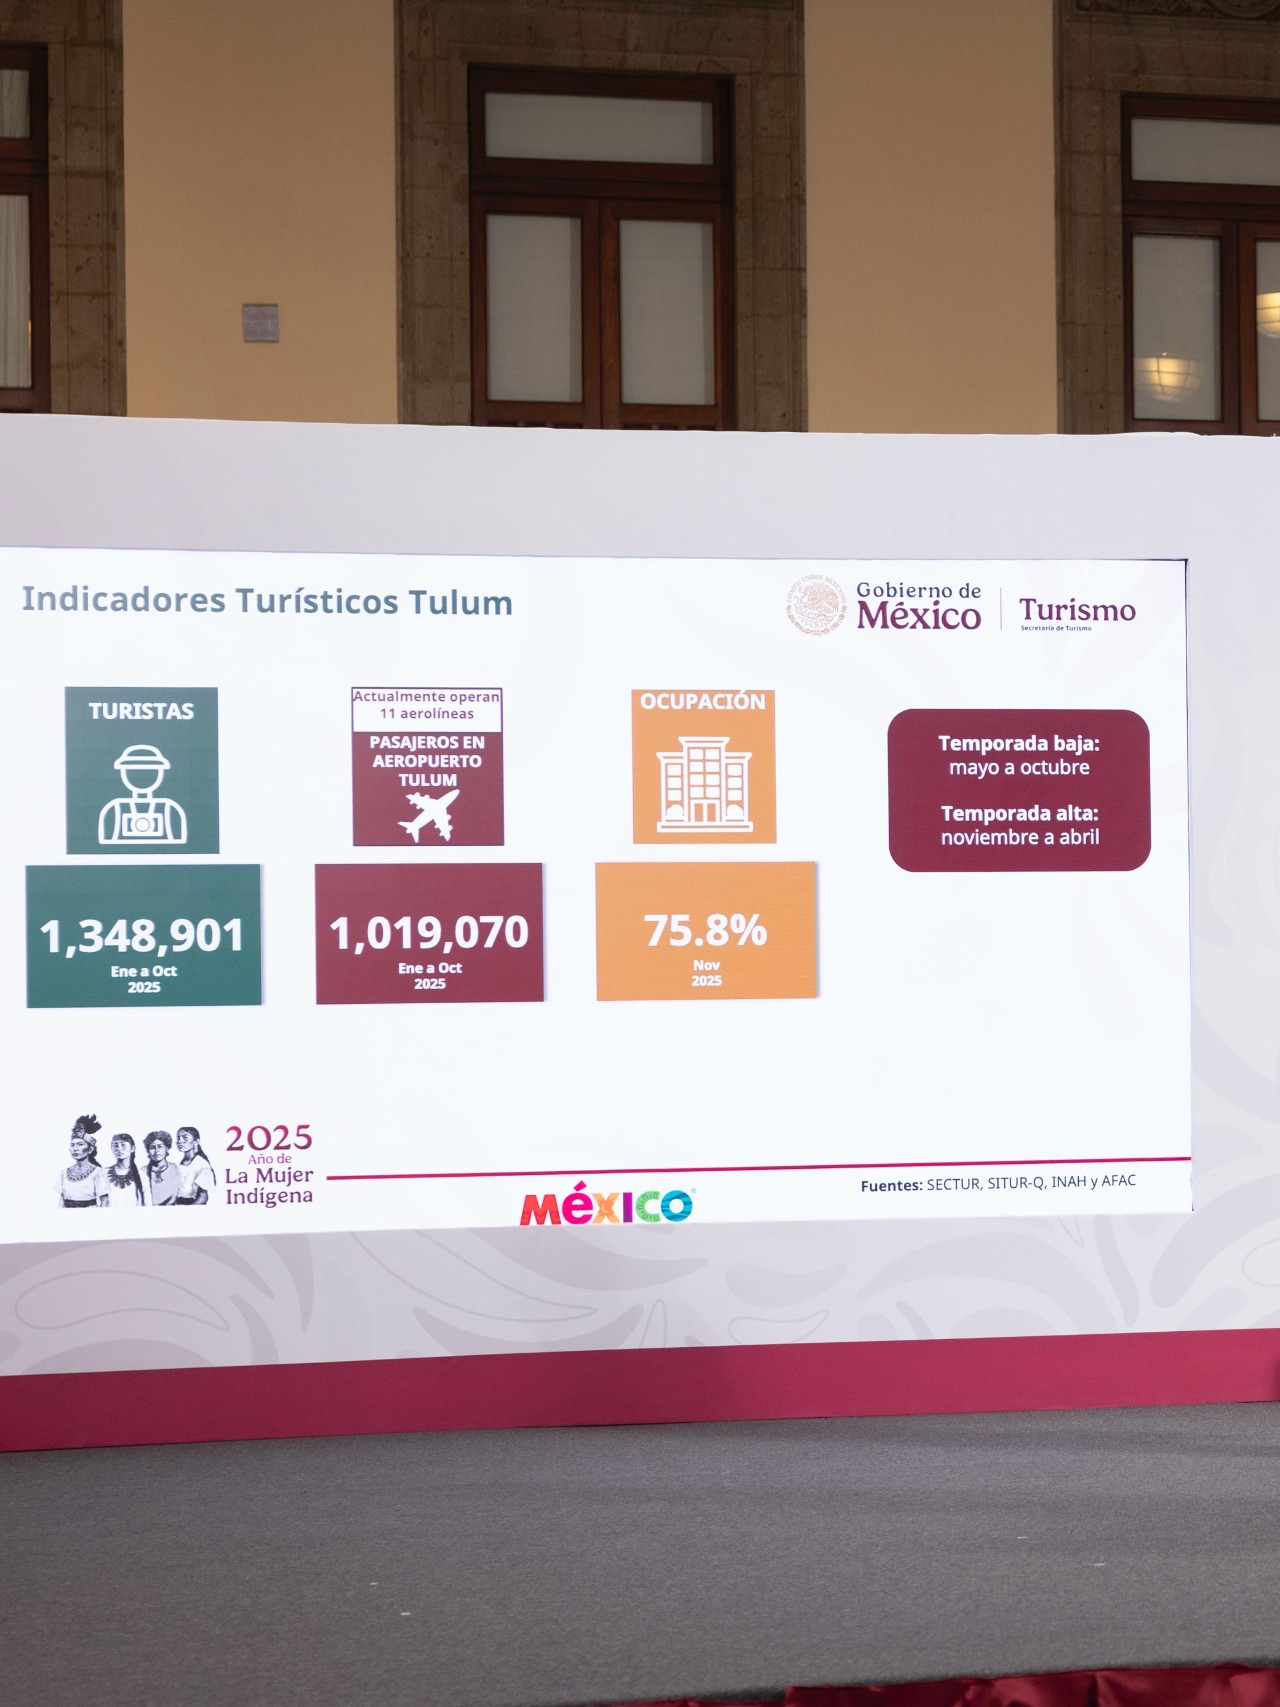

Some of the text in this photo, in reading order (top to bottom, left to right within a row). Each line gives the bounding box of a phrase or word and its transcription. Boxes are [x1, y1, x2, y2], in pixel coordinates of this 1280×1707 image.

[857, 582, 981, 598] Gobierno de
[23, 585, 512, 615] Indicadores Turísticos Tulum
[858, 600, 981, 629] México
[1019, 598, 1136, 621] Turismo
[353, 691, 500, 705] Actualmente operan
[640, 690, 765, 710] OCUPACIÓN
[89, 703, 194, 720] TURISTAS
[381, 708, 474, 719] 11 aerolíneas
[370, 736, 485, 752] PASAJEROS EN
[938, 735, 1099, 755] Temporada baja:
[372, 755, 482, 768] AEROPUERTO
[950, 758, 1090, 779] mayo a octubre
[399, 774, 457, 786] TULUM
[941, 804, 1098, 825] Temporada alta:
[942, 828, 1099, 845] noviembre a abril
[40, 918, 241, 958] 1,348,901
[330, 915, 528, 954] 1,019,070
[644, 913, 767, 947] 75.8%
[111, 965, 178, 977] Ene a Oct
[399, 962, 463, 974] Ene a Oct
[693, 960, 720, 971] Nov
[128, 982, 161, 993] 2025
[414, 978, 446, 989] 2025
[692, 975, 722, 986] 2025
[226, 1125, 312, 1151] 2025
[248, 1153, 291, 1164] Año de
[226, 1167, 313, 1187] La Mujer
[862, 1174, 1136, 1192] Fuentes: SECTUR, SITUR-Q, INAH y AFAC
[227, 1186, 312, 1208] Indígena
